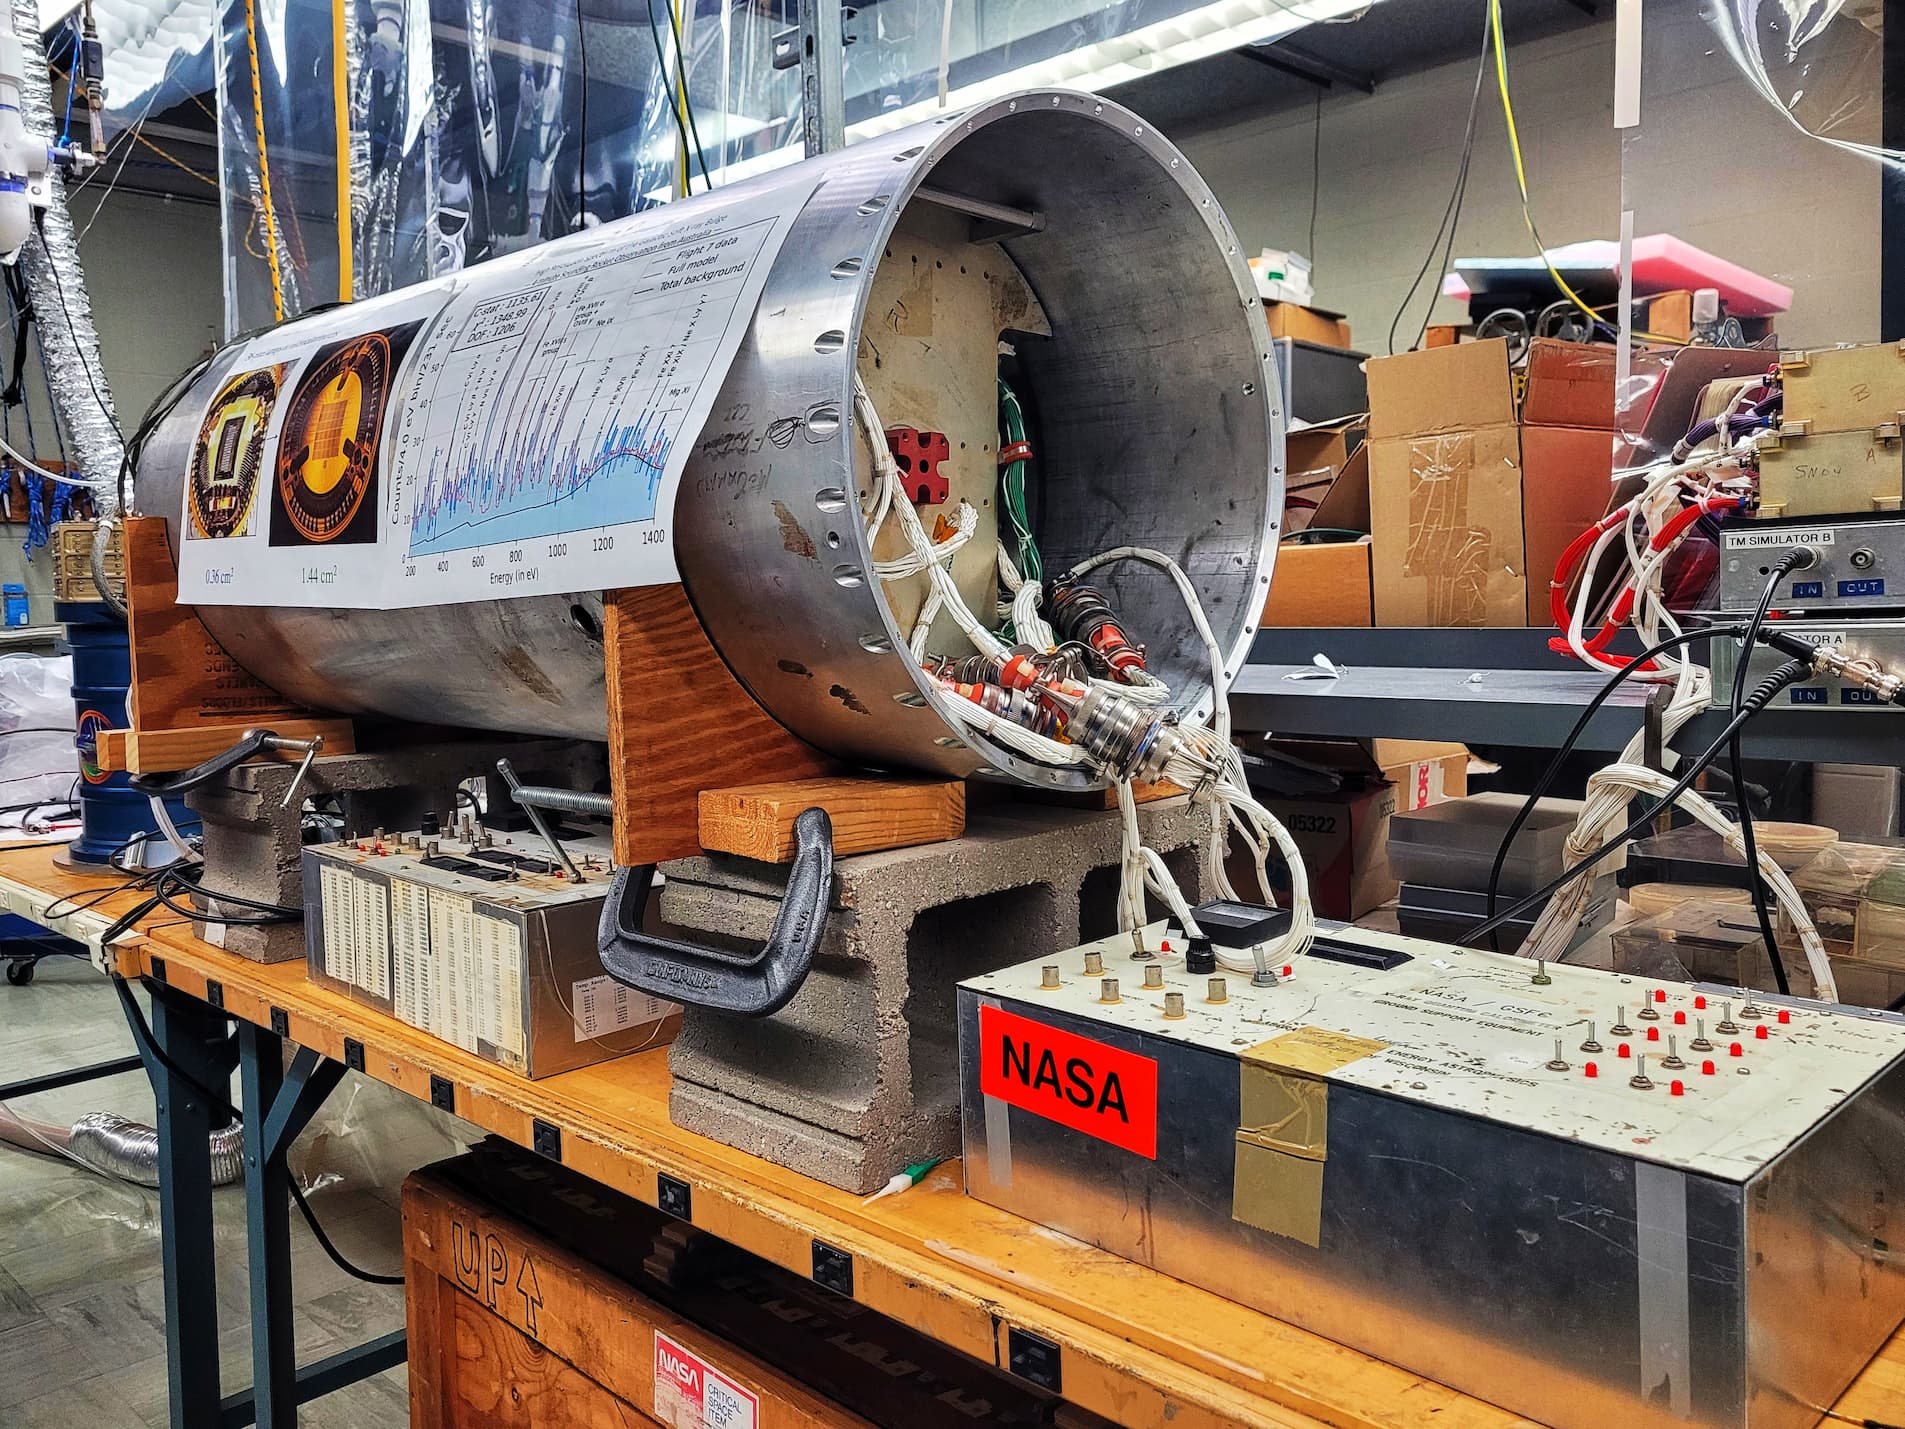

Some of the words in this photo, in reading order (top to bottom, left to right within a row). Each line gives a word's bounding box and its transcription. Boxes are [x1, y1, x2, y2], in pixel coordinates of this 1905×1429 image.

[676, 244, 704, 260] Flight
[705, 240, 713, 250] 7
[715, 235, 739, 250] data
[667, 262, 686, 276] Full
[686, 254, 719, 270] model
[659, 276, 684, 293] Total
[684, 262, 746, 285] background
[490, 307, 528, 325] 1348.99
[492, 322, 516, 337] 1206
[406, 408, 414, 428] eV
[436, 316, 453, 340] sec
[668, 387, 681, 397] Mg
[1866, 448, 1876, 464] A
[403, 513, 412, 525] 10
[593, 536, 614, 552] 1200
[642, 529, 665, 545] 1400
[1729, 536, 1747, 546] TM
[1749, 534, 1818, 546] SIMULATOR
[1823, 532, 1831, 542] B
[509, 549, 523, 563] 800
[548, 543, 568, 558] 1000
[437, 560, 449, 573] 400
[472, 555, 485, 568] 600
[301, 568, 318, 584] 1.44
[405, 565, 417, 577] 200
[490, 570, 514, 585] Energy
[515, 570, 525, 582] (in
[526, 567, 540, 581] eV)
[1800, 586, 1818, 595] IN
[1847, 582, 1878, 593] OUT
[1834, 634, 1843, 645] A
[1798, 691, 1817, 700] IN
[1851, 692, 1873, 701] OU
[1288, 814, 1337, 834] 05322
[1382, 991, 1423, 1005] X-RAY
[1419, 988, 1468, 1004] NASA
[1373, 999, 1419, 1013] GROUND
[1420, 1008, 1475, 1024] SUPPORT
[1475, 1019, 1545, 1037] EQUIPMENT
[1386, 1049, 1438, 1064] ENERGY
[1383, 1058, 1451, 1077] WISCONSIN
[1001, 1034, 1130, 1125] NASA
[451, 1221, 508, 1310] UP
[659, 1348, 700, 1392] NASA
[707, 1383, 743, 1415] CRITICAL
[707, 1396, 733, 1421] SPACE
[708, 1408, 727, 1427] ITEM
